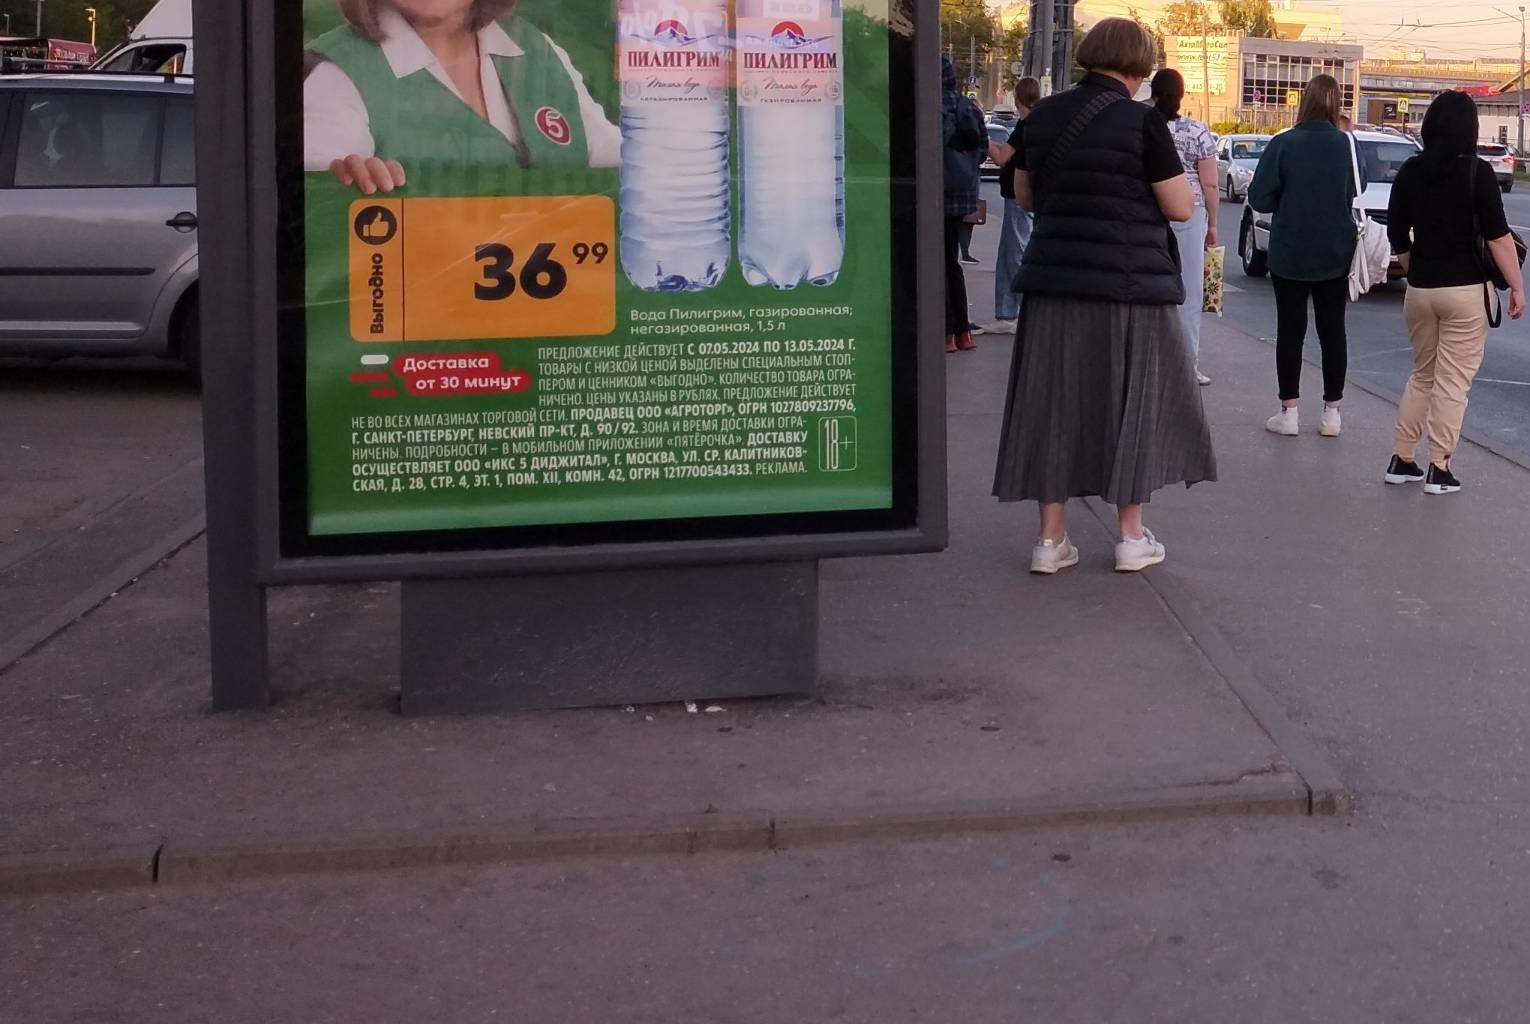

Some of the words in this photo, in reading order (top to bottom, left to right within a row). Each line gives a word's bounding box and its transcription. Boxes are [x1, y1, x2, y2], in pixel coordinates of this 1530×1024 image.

[628, 51, 720, 68] ПИЛИГРИМ
[743, 52, 838, 69] ПИЛИГРИМ
[474, 242, 568, 301] 36
[572, 242, 609, 264] 99
[368, 253, 384, 334] Выгодно
[630, 309, 666, 322] Вода
[669, 308, 745, 322] Пилигрим,
[749, 305, 853, 319] газированная;
[630, 322, 754, 336] негазированная,
[758, 321, 774, 334] 1,5
[777, 321, 786, 331] л
[538, 345, 620, 361] ПРЕДЛОЖЕНИЕ
[624, 342, 684, 358] ДЕЙСТВУЕТ
[687, 343, 695, 355] С
[698, 342, 760, 355] 07.05.2024
[763, 341, 780, 353] ПО
[784, 339, 844, 352] 13.05.2024
[848, 338, 856, 350] Г.
[403, 358, 489, 373] Доставка
[538, 363, 581, 376] ТОВАРЫ
[585, 361, 591, 373] С
[595, 358, 637, 373] НИЗКОЙ
[640, 356, 677, 373] ЦЕНОЙ
[680, 357, 739, 372] ВЫДЕЛЕНЫ
[742, 355, 822, 369] СПЕЦИАЛЬНЫМ
[826, 353, 856, 366] СТОП-
[416, 379, 435, 390] от
[440, 377, 459, 388] 30
[465, 376, 521, 390] минут
[538, 378, 575, 391] ПЕРОМ
[579, 377, 585, 389] И
[588, 376, 647, 390] ЦЕННИКОМ
[650, 373, 717, 387] «ВЫГОДНО».
[720, 370, 784, 384] КОЛИЧЕСТВО
[787, 369, 825, 382] ТОВАРА
[828, 368, 856, 381] ОГРА-
[539, 393, 584, 406] НИЧЕНО.
[586, 392, 616, 406] ЦЕНЫ
[619, 390, 668, 403] УКАЗАНЫ
[670, 389, 676, 402] В
[679, 388, 720, 401] РУБЛЯХ.
[723, 385, 798, 400] ПРЕДЛОЖЕНИЕ
[801, 383, 856, 399] ДЕЙСТВУЕТ
[352, 416, 365, 429] НЕ
[368, 416, 382, 428] ВО
[385, 415, 411, 428] ВСЕХ
[414, 413, 479, 426] МАГАЗИНАХ
[482, 408, 536, 424] ТОРГОВОЙ
[540, 409, 568, 422] СЕТИ.
[571, 407, 634, 421] ПРОДАВЕЦ
[637, 406, 661, 417] ООО
[665, 403, 735, 416] «АГРОТОРГ»,
[738, 402, 767, 414] ОГРН
[771, 399, 856, 413] 1027809237796,
[352, 432, 360, 444] Г.
[363, 428, 475, 444] САНКТ-ПЕТЕРБУРГ,
[479, 423, 535, 439] НЕВСКИЙ
[539, 425, 576, 437] ПР-КТ,
[580, 424, 593, 437] Д.
[641, 421, 669, 434] ЗОНА
[673, 421, 680, 432] И
[683, 419, 718, 432] ВРЕМЯ
[721, 416, 775, 432] ДОСТАВКИ
[778, 416, 807, 428] ОГРА-
[406, 443, 487, 459] ПОДРОБНОСТИ
[502, 442, 509, 455] В
[512, 439, 585, 454] МОБИЛЬНОМ
[588, 436, 663, 451] ПРИЛОЖЕНИИ
[747, 431, 808, 446] ДОСТАВКУ
[352, 460, 451, 476] ОСУЩЕСТВЛЯЕТ
[454, 459, 480, 472] ООО
[484, 458, 516, 471] «ИКС
[520, 457, 527, 469] 5
[531, 454, 610, 470] ДИДЖИТАЛ»,
[614, 454, 622, 465] Г.
[626, 451, 678, 464] МОСКВА,
[682, 450, 700, 462] УЛ.
[704, 449, 720, 461] СР.
[724, 447, 807, 461] КАЛИТНИКОВ-
[352, 479, 388, 492] СКАЯ,
[392, 478, 405, 492] Д.
[409, 477, 427, 490] 28,
[431, 476, 455, 489] СТР.
[458, 475, 470, 489] 4,
[474, 474, 490, 487] ЭТ.
[494, 474, 503, 488] 1,
[507, 472, 538, 485] ПОМ.
[566, 470, 605, 483] КОМН.
[608, 468, 625, 482] 42,
[629, 466, 659, 480] ОГРН
[756, 461, 808, 474] РЕКЛАМА.
